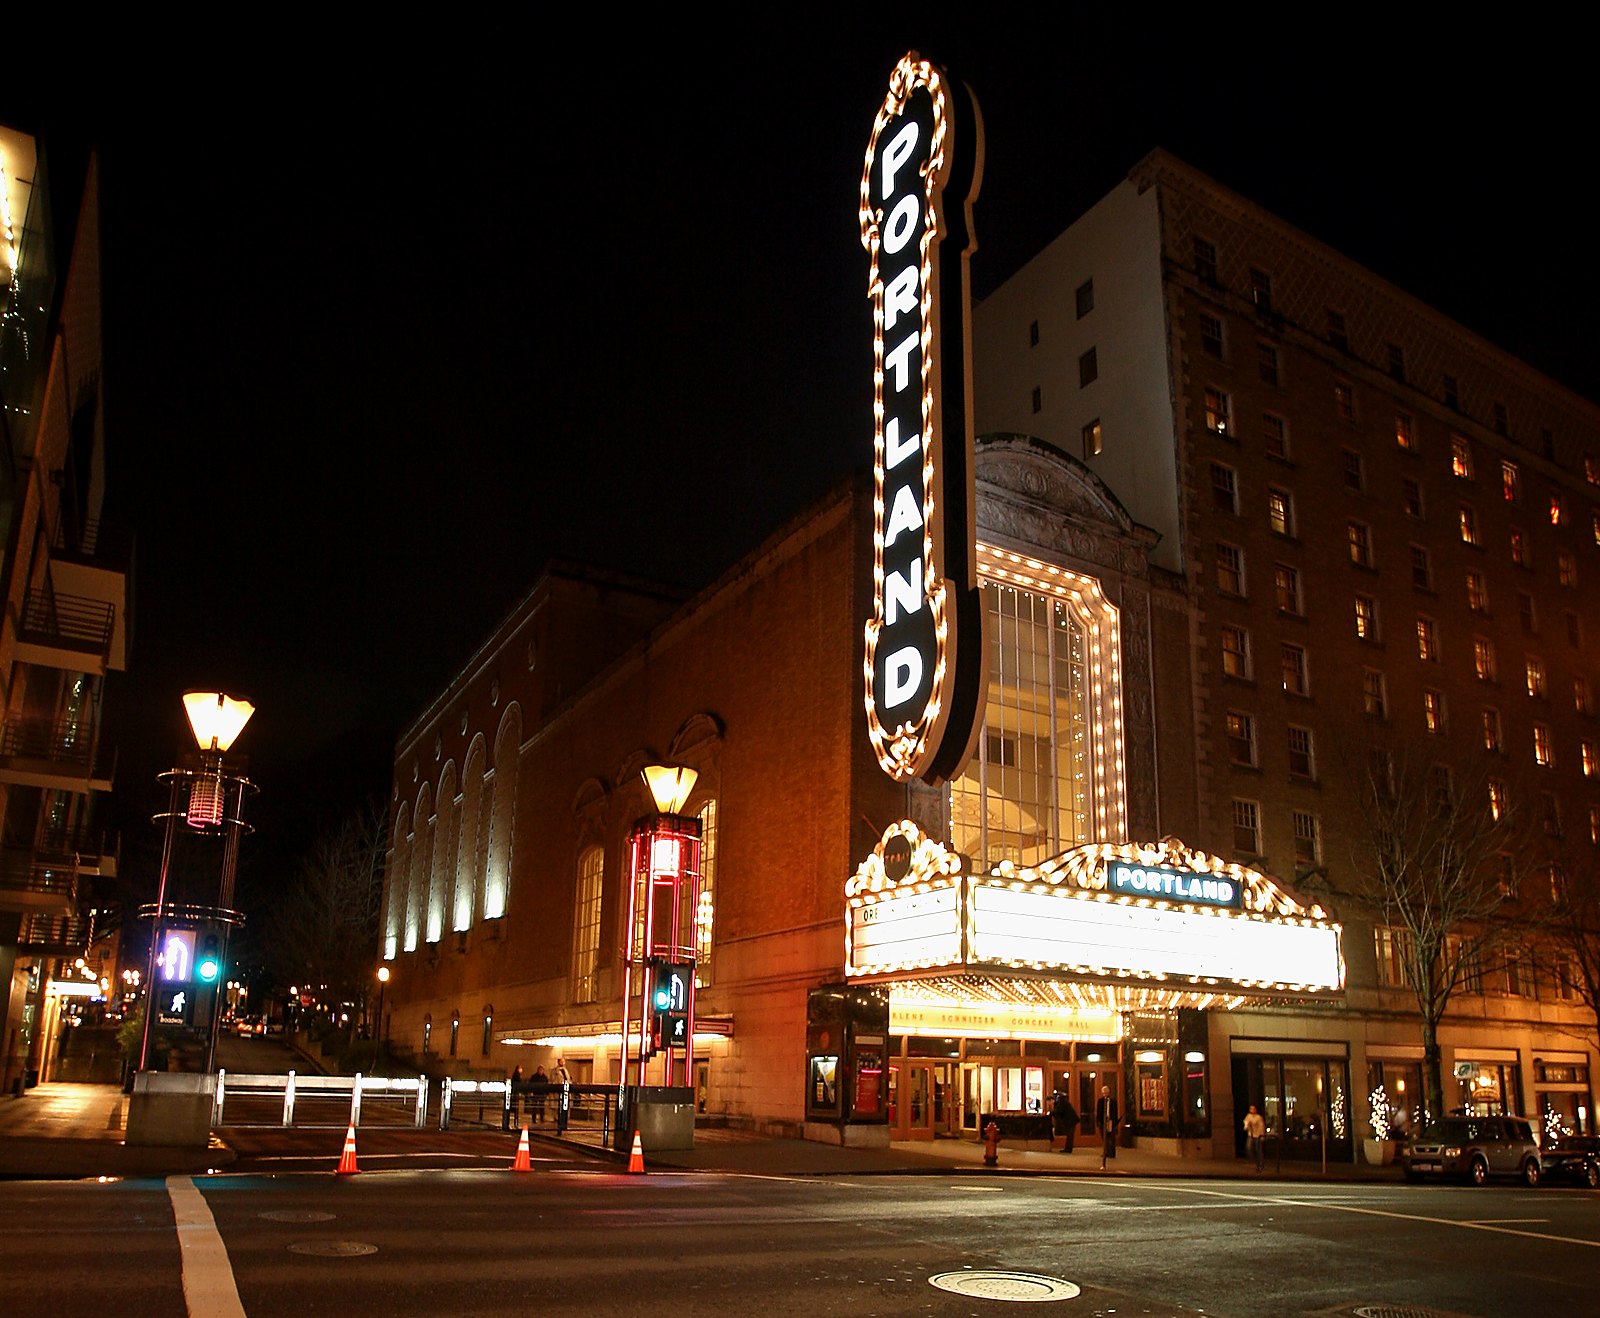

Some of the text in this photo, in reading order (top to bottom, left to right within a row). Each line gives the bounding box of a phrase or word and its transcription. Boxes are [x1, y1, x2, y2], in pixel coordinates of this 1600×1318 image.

[881, 121, 924, 710] PORTLAND
[1116, 867, 1234, 902] PORTLAND
[1011, 1018, 1054, 1027] CONCERT
[1069, 1021, 1089, 1029] HALL
